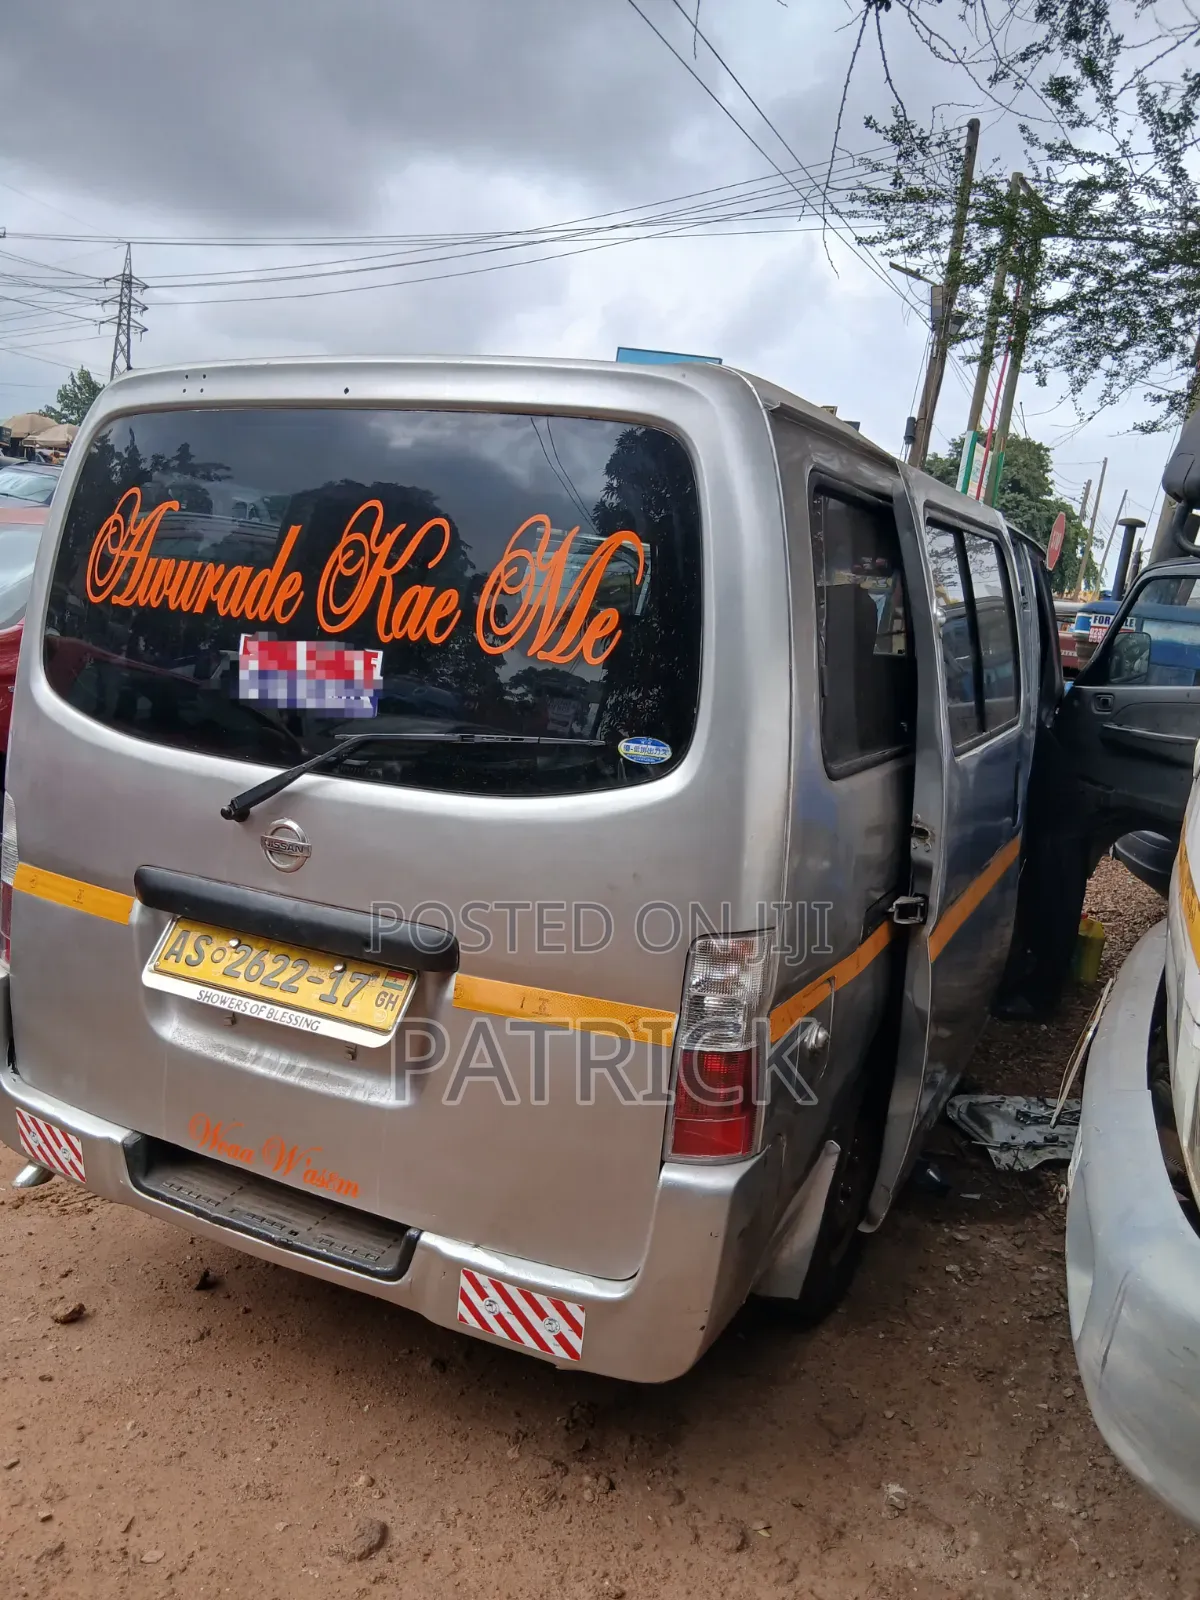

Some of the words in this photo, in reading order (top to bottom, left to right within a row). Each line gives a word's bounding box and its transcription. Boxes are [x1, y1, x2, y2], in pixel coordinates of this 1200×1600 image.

[86, 486, 303, 624] Awurade
[317, 499, 462, 643] Kae
[476, 513, 644, 665] Me
[1093, 615, 1111, 625] FOR
[264, 838, 305, 854] NISSAN
[164, 929, 213, 967] AS
[222, 943, 371, 1008] 2622-17
[196, 989, 249, 1014] SHOWERS
[249, 1003, 267, 1017] OF
[266, 1007, 321, 1032] BLESSING
[374, 990, 400, 1012] GH
